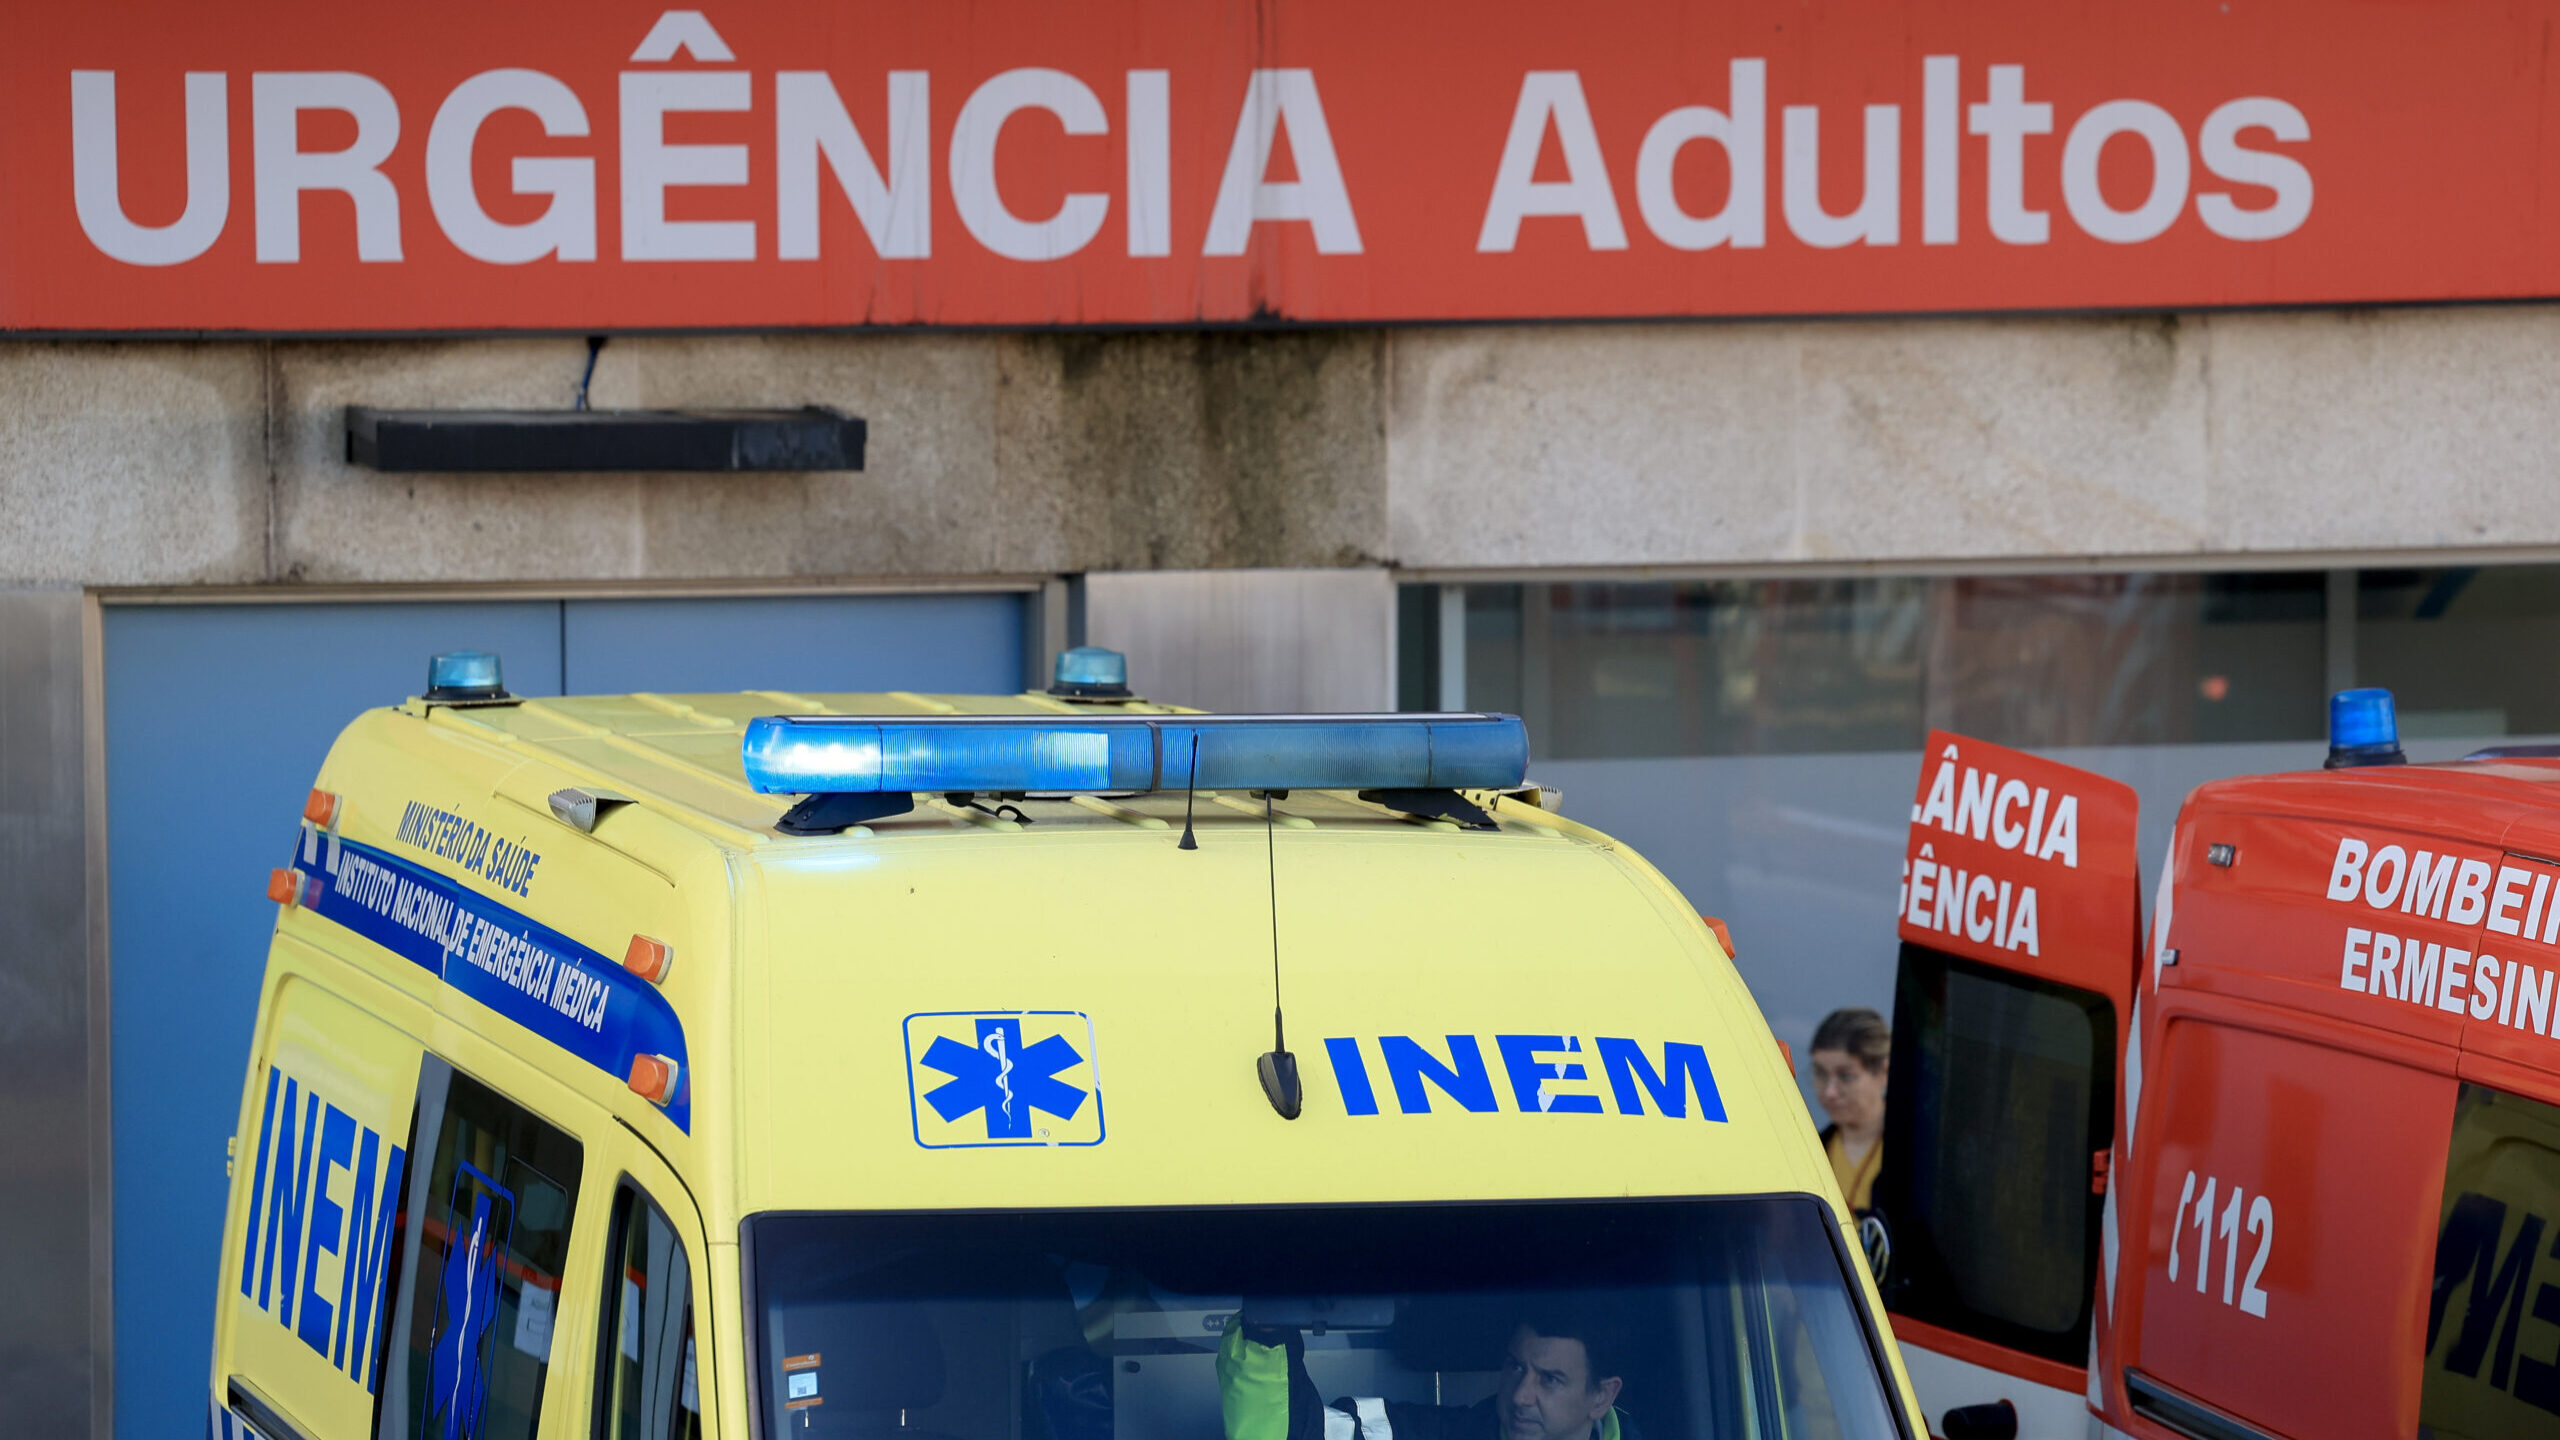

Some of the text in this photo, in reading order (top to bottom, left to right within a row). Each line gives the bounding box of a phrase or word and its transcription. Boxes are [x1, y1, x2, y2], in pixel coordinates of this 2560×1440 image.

[71, 10, 2314, 265] URGÊNCIA Adultos
[396, 800, 541, 898] MINISTÉRIO DA SAÚDE
[1910, 745, 2078, 868] ÂNCIA
[335, 850, 610, 1033] INSTITUTO NACIONAL DE EMERGÊNCIA MÉDICA
[2340, 927, 2560, 1040] ERMESIN
[1323, 1034, 1729, 1123] INEM
[241, 1065, 406, 1397] INEM
